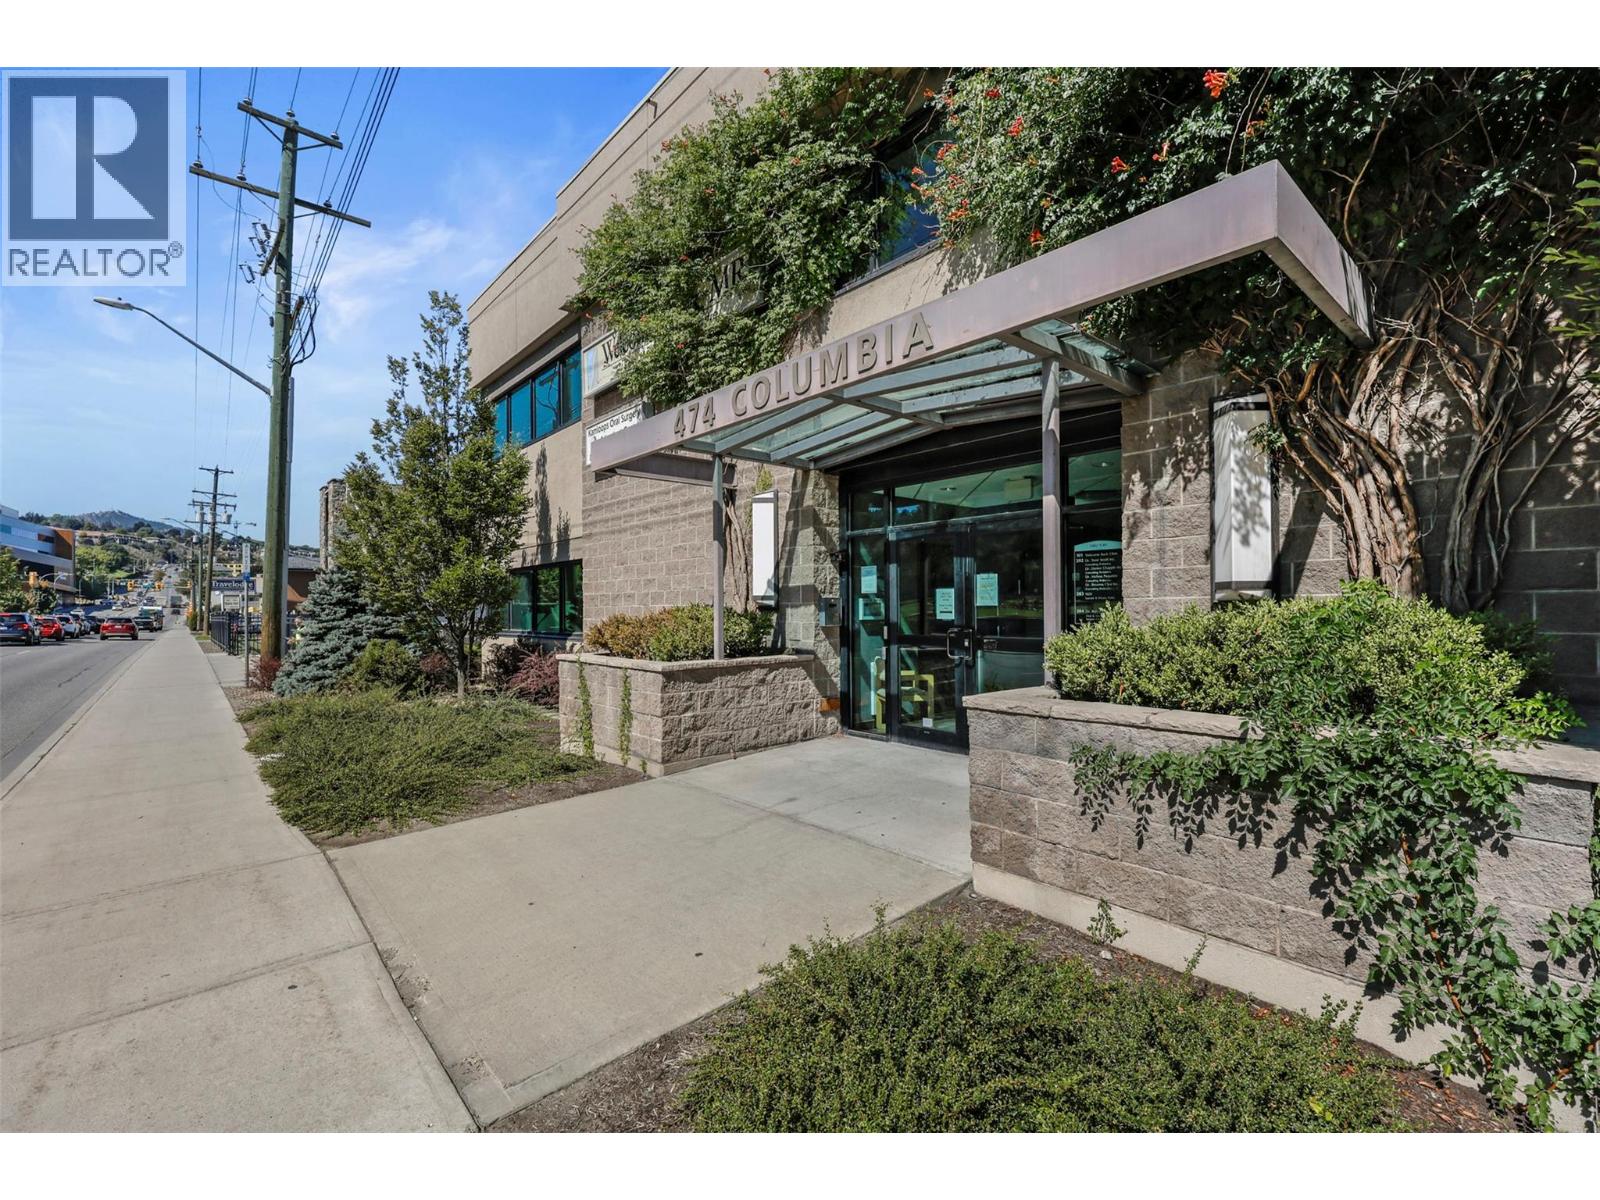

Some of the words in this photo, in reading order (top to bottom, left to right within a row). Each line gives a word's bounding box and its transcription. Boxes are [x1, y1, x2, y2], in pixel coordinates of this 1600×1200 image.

[673, 396, 716, 437] 474
[731, 312, 935, 417] COLUMBIA
[588, 422, 610, 436] Kamloops
[610, 416, 621, 428] Oral
[621, 408, 641, 423] Surgery
[212, 580, 255, 589] Travelode
